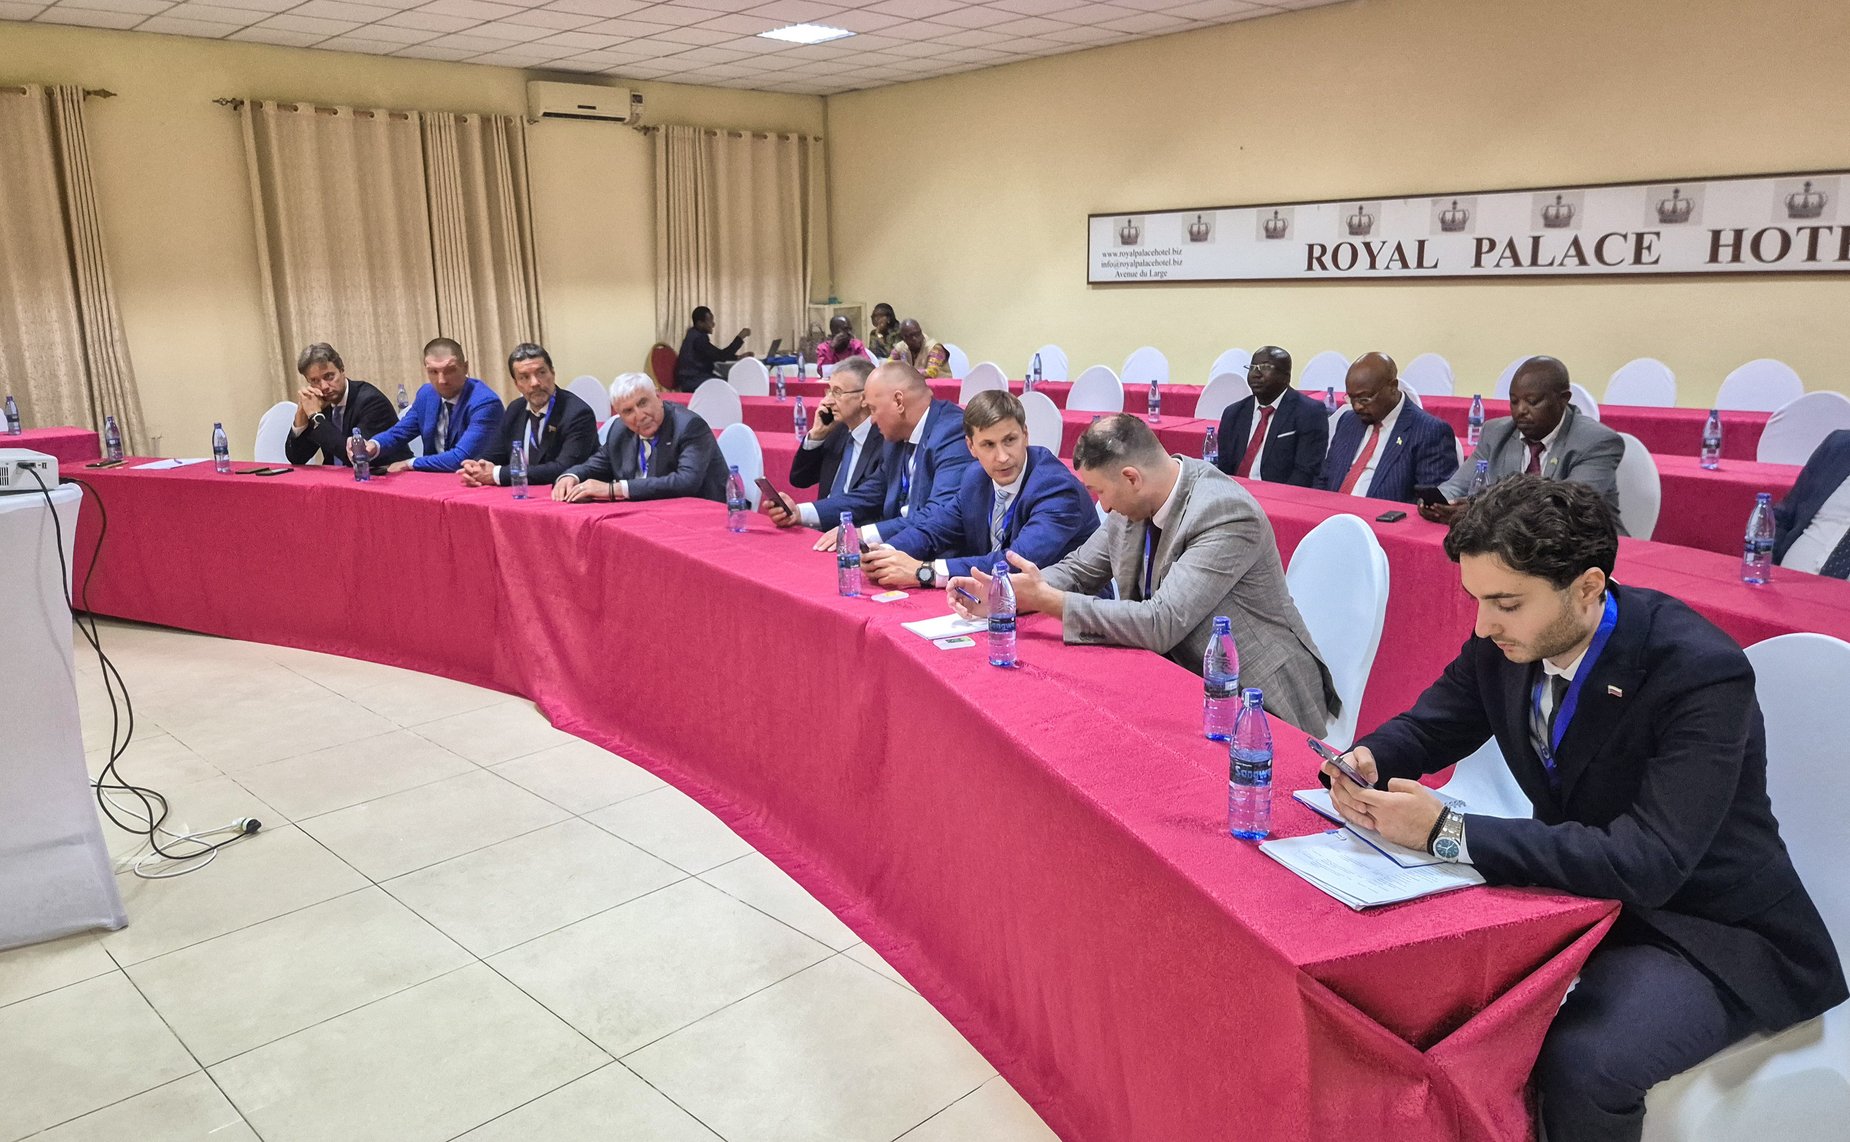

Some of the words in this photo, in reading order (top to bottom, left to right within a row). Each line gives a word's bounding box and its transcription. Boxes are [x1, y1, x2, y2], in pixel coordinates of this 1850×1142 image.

[1102, 247, 1183, 259] www.royalpalacehotel.biz
[1304, 239, 1440, 272] ROYAL
[1470, 231, 1662, 269] PALACE
[1101, 258, 1183, 270] info@royalpalacehotel.biz
[1115, 270, 1138, 278] Avenue
[1139, 269, 1148, 278] du
[1149, 269, 1168, 279] Large
